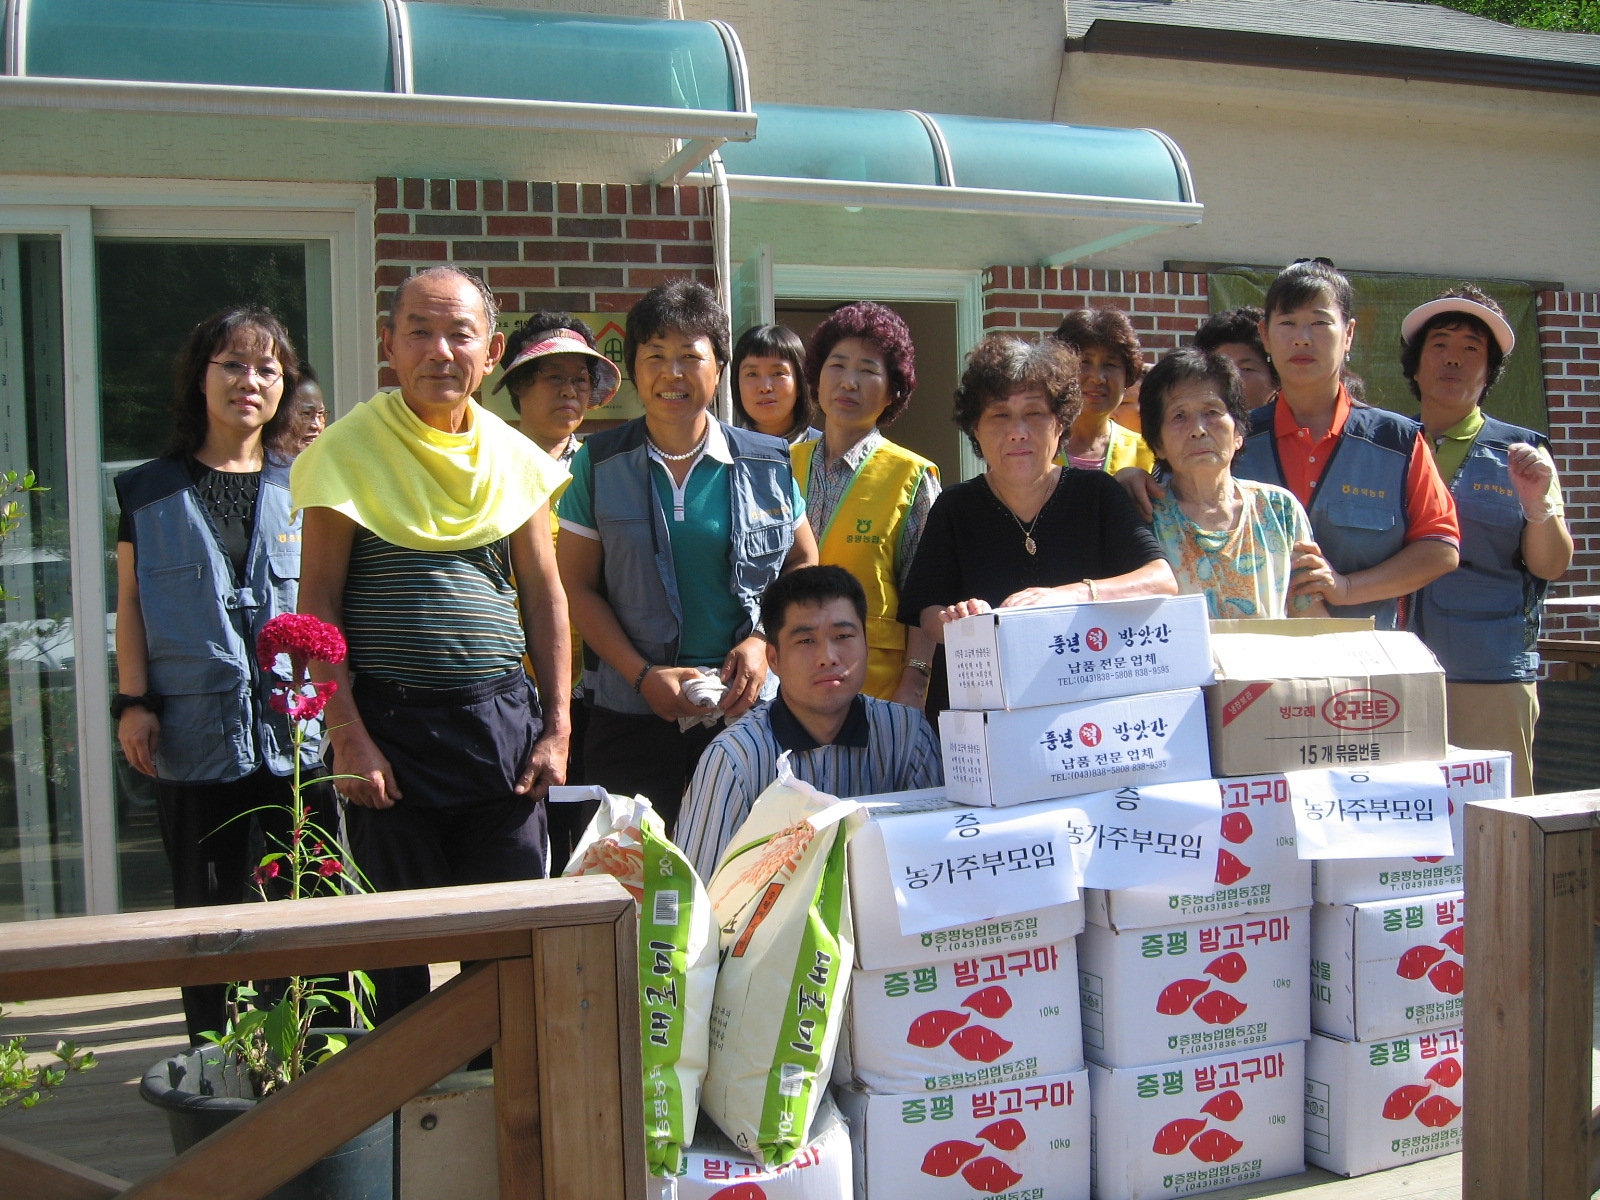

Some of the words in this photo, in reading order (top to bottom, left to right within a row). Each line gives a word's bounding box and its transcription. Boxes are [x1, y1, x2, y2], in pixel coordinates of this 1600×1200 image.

[1048, 632, 1081, 655] 풍년
[1118, 623, 1172, 648] 방앗간
[1068, 660, 1095, 675] 납품
[1099, 656, 1127, 671] 전문
[1130, 653, 1157, 668] 업체
[1134, 665, 1170, 679] 838-9595
[1279, 705, 1316, 719] 빙그레
[1332, 699, 1390, 721] 요구르트
[1040, 728, 1073, 751] 풍년
[1113, 717, 1168, 742] 방앗간
[1061, 756, 1090, 770] 납품
[1094, 752, 1122, 767] 전문
[1127, 747, 1154, 762] 업체
[1336, 742, 1381, 762] 묶음번들
[1440, 760, 1492, 788] 구마
[1220, 779, 1291, 809] 고구마
[1304, 798, 1433, 822] 농가주부모임
[954, 813, 981, 838] 증
[1067, 820, 1202, 859] 농가주부모임
[1276, 836, 1294, 847] 10kg
[905, 842, 1056, 889] 농가주부모임
[1390, 864, 1463, 883] 증평농업협동조
[1391, 876, 1464, 891] T.(043)836-69
[1181, 896, 1271, 915] T.(043)836-6995
[1383, 905, 1423, 931] 증평
[935, 917, 1038, 944] 증평농업협동조합
[936, 930, 1038, 952] T.(043)836-6995
[1141, 931, 1188, 959] 증평
[1200, 916, 1290, 953] 밤고구마
[884, 966, 937, 997] 증평
[954, 946, 1058, 988] 밤고구마
[1273, 978, 1291, 989] 10kg
[644, 940, 677, 1046] 새로미
[790, 950, 832, 1054] 새로미
[1039, 1005, 1059, 1018] 10kg
[1415, 998, 1463, 1017] 증평농업협
[1180, 1022, 1268, 1046] 증평농업협동조합
[1180, 1034, 1268, 1055] T.(043)836-6995
[1369, 1038, 1410, 1067] 증평
[1419, 1028, 1463, 1060] 밤고
[938, 1057, 1038, 1088] 증평농업협동조합
[1137, 1069, 1184, 1099] 증평
[1195, 1052, 1284, 1093] 밤고구마
[902, 1095, 954, 1124] 증평
[972, 1080, 1075, 1119] 밤고구마
[1268, 1114, 1286, 1125] 10kg
[1050, 1138, 1070, 1150] 10kg
[1401, 1127, 1463, 1149] 증평농업협동
[704, 1145, 820, 1179] 밤고마
[1174, 1158, 1262, 1185] 증평농업협동조합
[1175, 1169, 1262, 1194] T.(043)836-6995
